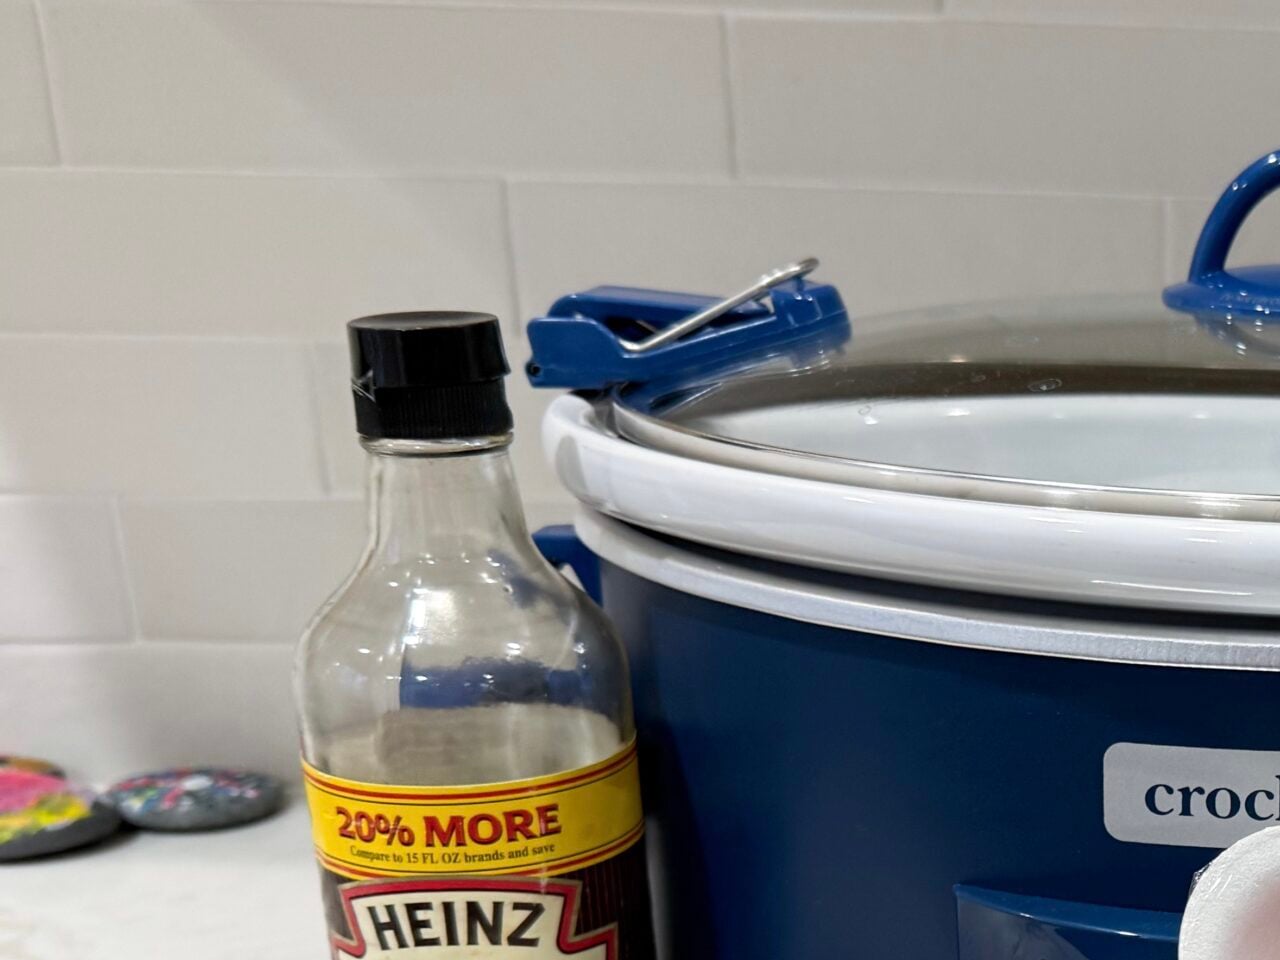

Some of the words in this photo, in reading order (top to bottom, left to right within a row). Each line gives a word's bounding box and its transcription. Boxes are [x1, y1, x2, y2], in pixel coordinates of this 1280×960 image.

[336, 806, 415, 847] 20%
[423, 803, 563, 848] MORE
[350, 845, 391, 863] Compare
[393, 854, 403, 864] to
[406, 852, 419, 864] 15
[422, 852, 439, 865] FL
[442, 852, 461, 864] OZ
[464, 850, 505, 864] brands
[508, 846, 529, 860] and
[532, 843, 556, 856] save
[367, 901, 545, 950] HEINZ
